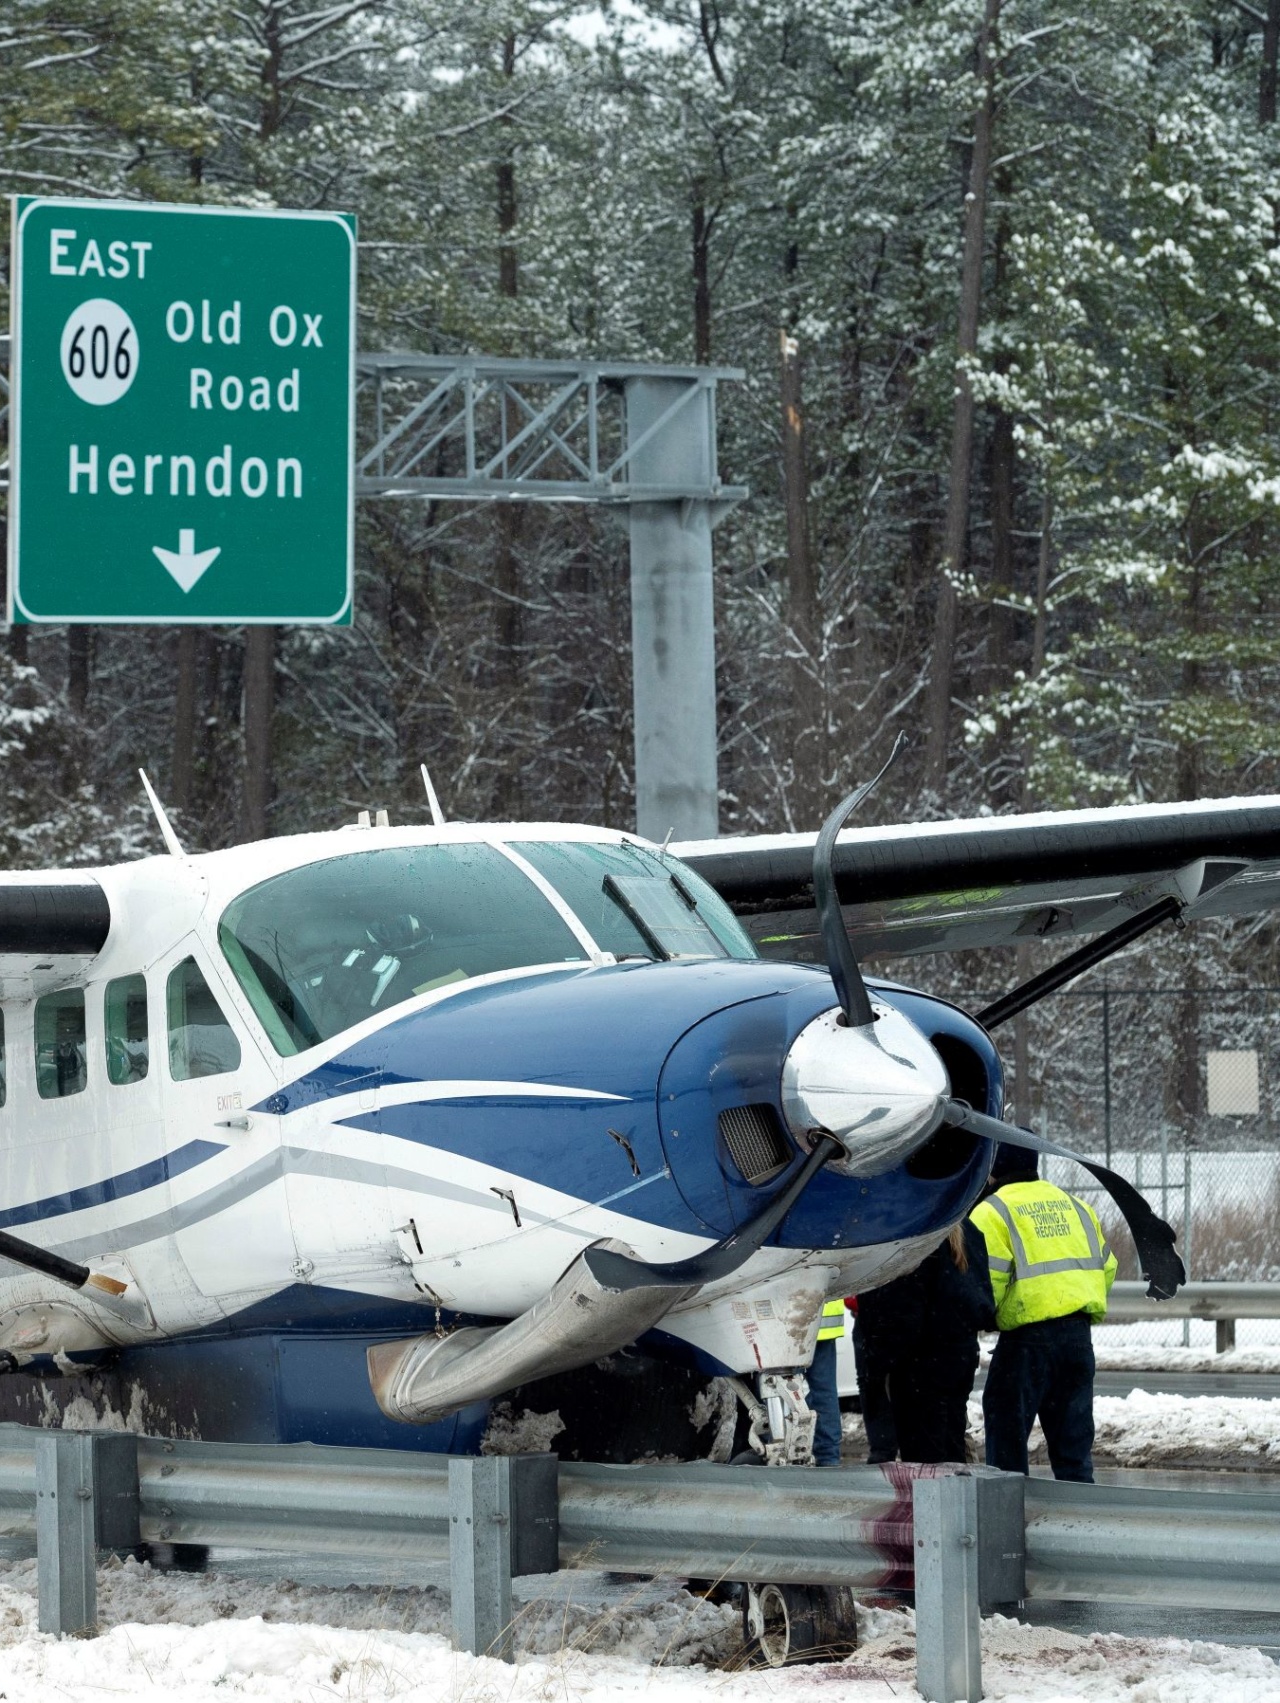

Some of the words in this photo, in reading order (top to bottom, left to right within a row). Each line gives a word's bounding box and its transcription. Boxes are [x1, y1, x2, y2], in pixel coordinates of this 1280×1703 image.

[51, 230, 151, 277] EAST
[167, 301, 240, 343] Old
[270, 306, 321, 346] Ox
[69, 325, 130, 379] 606
[191, 369, 298, 411] Road
[70, 446, 301, 497] Herndon
[217, 1095, 233, 1110] EXIT
[1015, 1201, 1047, 1216] WILLOW
[1046, 1199, 1072, 1212] SPRING
[1031, 1213, 1059, 1226] TOWING
[1060, 1212, 1067, 1223] &
[1034, 1224, 1071, 1238] RECOVERY
